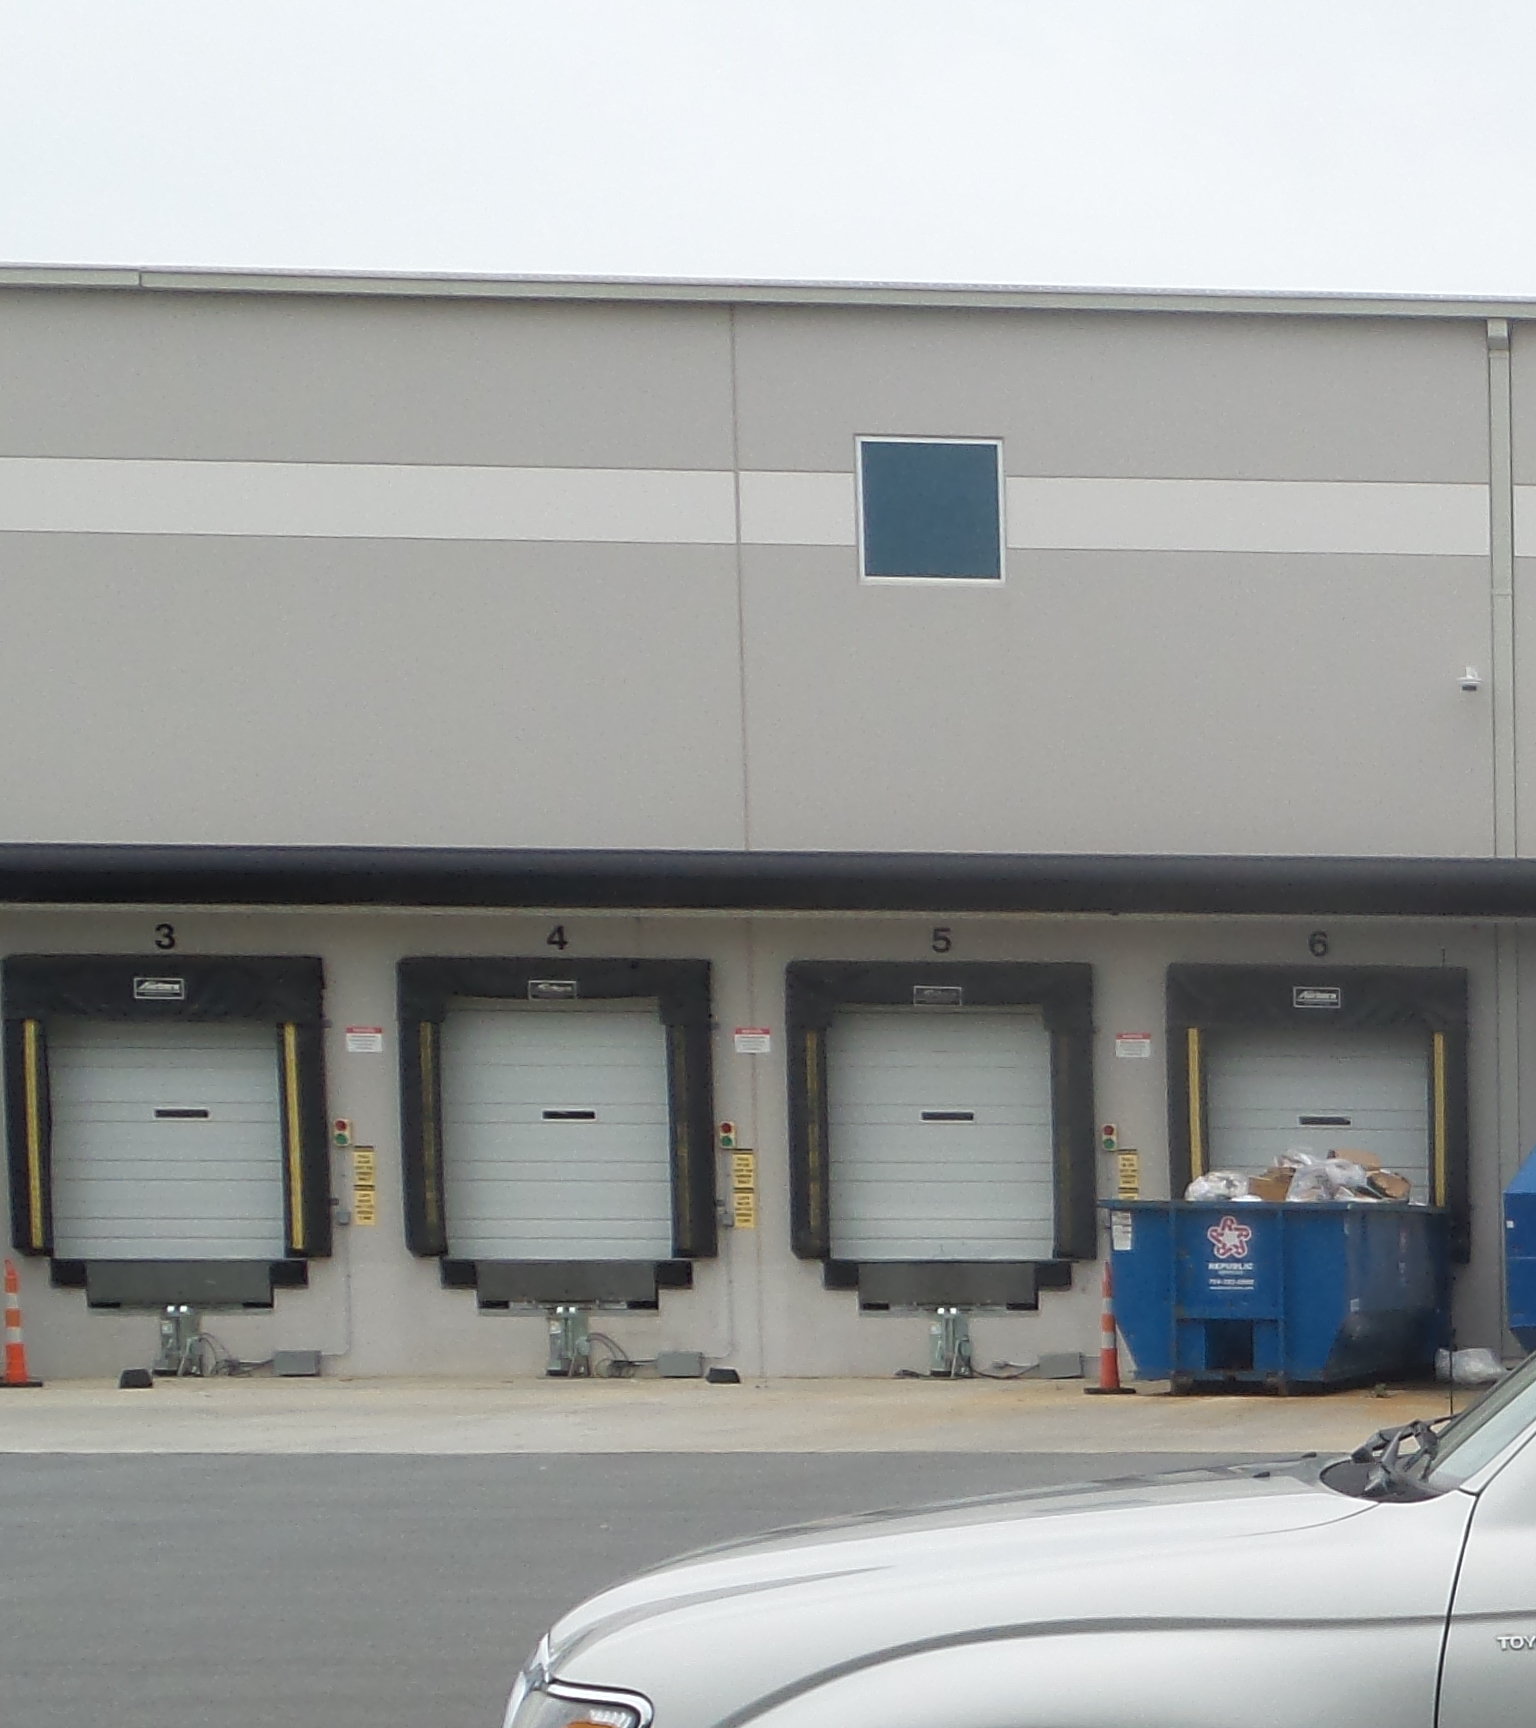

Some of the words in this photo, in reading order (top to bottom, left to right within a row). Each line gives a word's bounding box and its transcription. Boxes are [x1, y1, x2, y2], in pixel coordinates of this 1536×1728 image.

[155, 923, 176, 949] 3
[546, 925, 568, 951] 4
[932, 927, 951, 953] 5
[1309, 930, 1328, 957] 6
